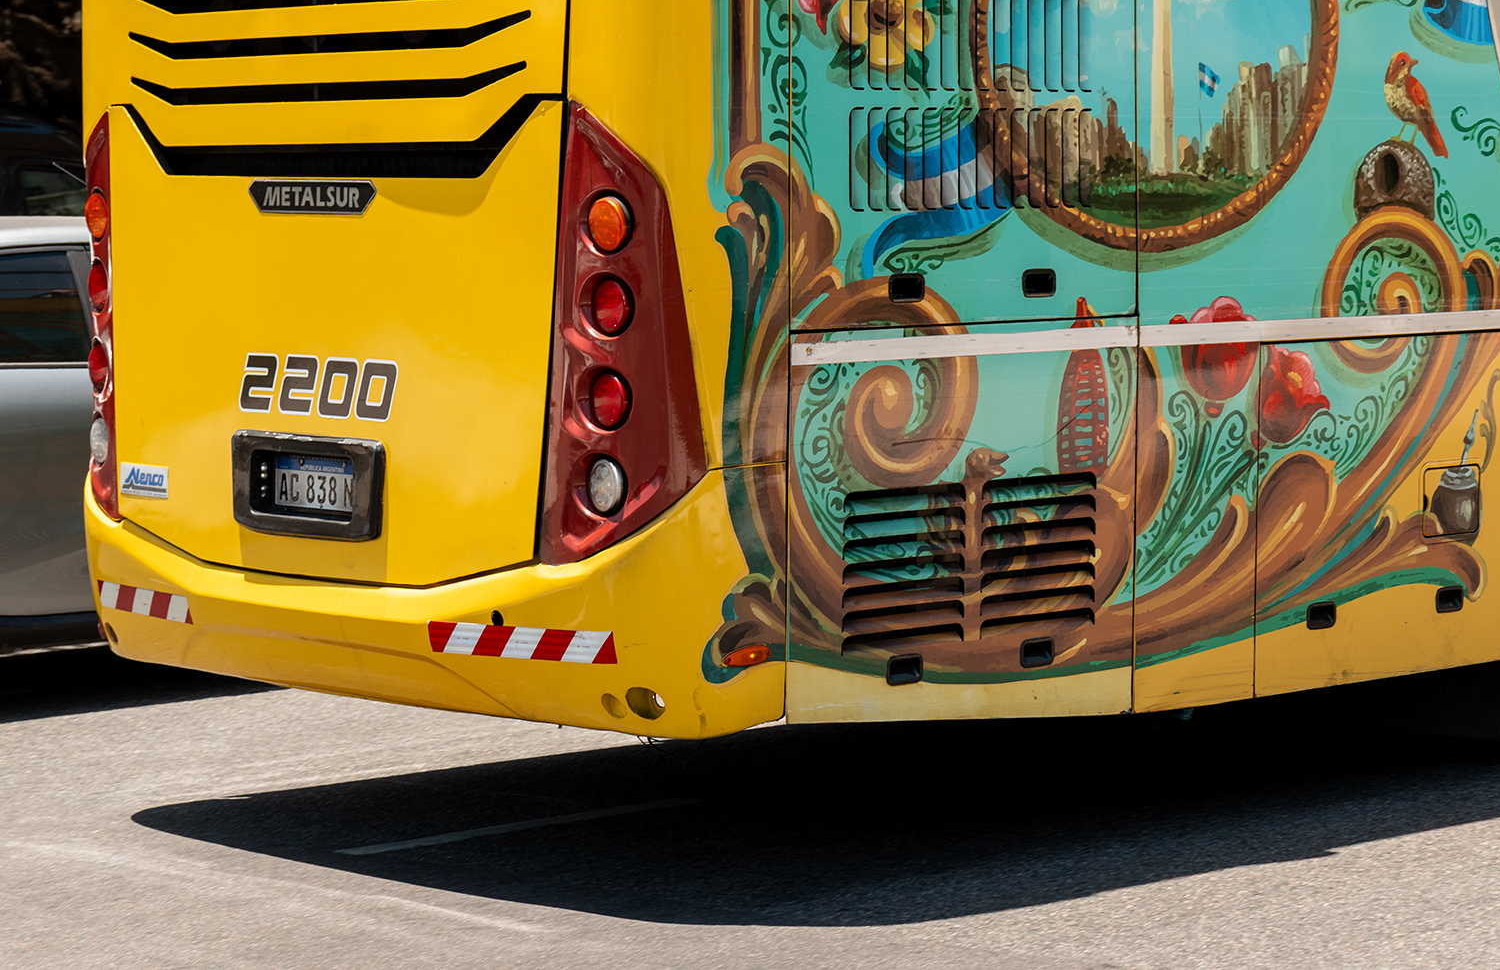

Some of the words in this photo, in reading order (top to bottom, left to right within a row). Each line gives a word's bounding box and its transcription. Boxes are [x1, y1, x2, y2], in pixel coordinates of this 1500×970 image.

[262, 186, 360, 209] METALSUR
[238, 352, 399, 423] 2200
[279, 473, 299, 502] AC
[306, 474, 337, 506] 838
